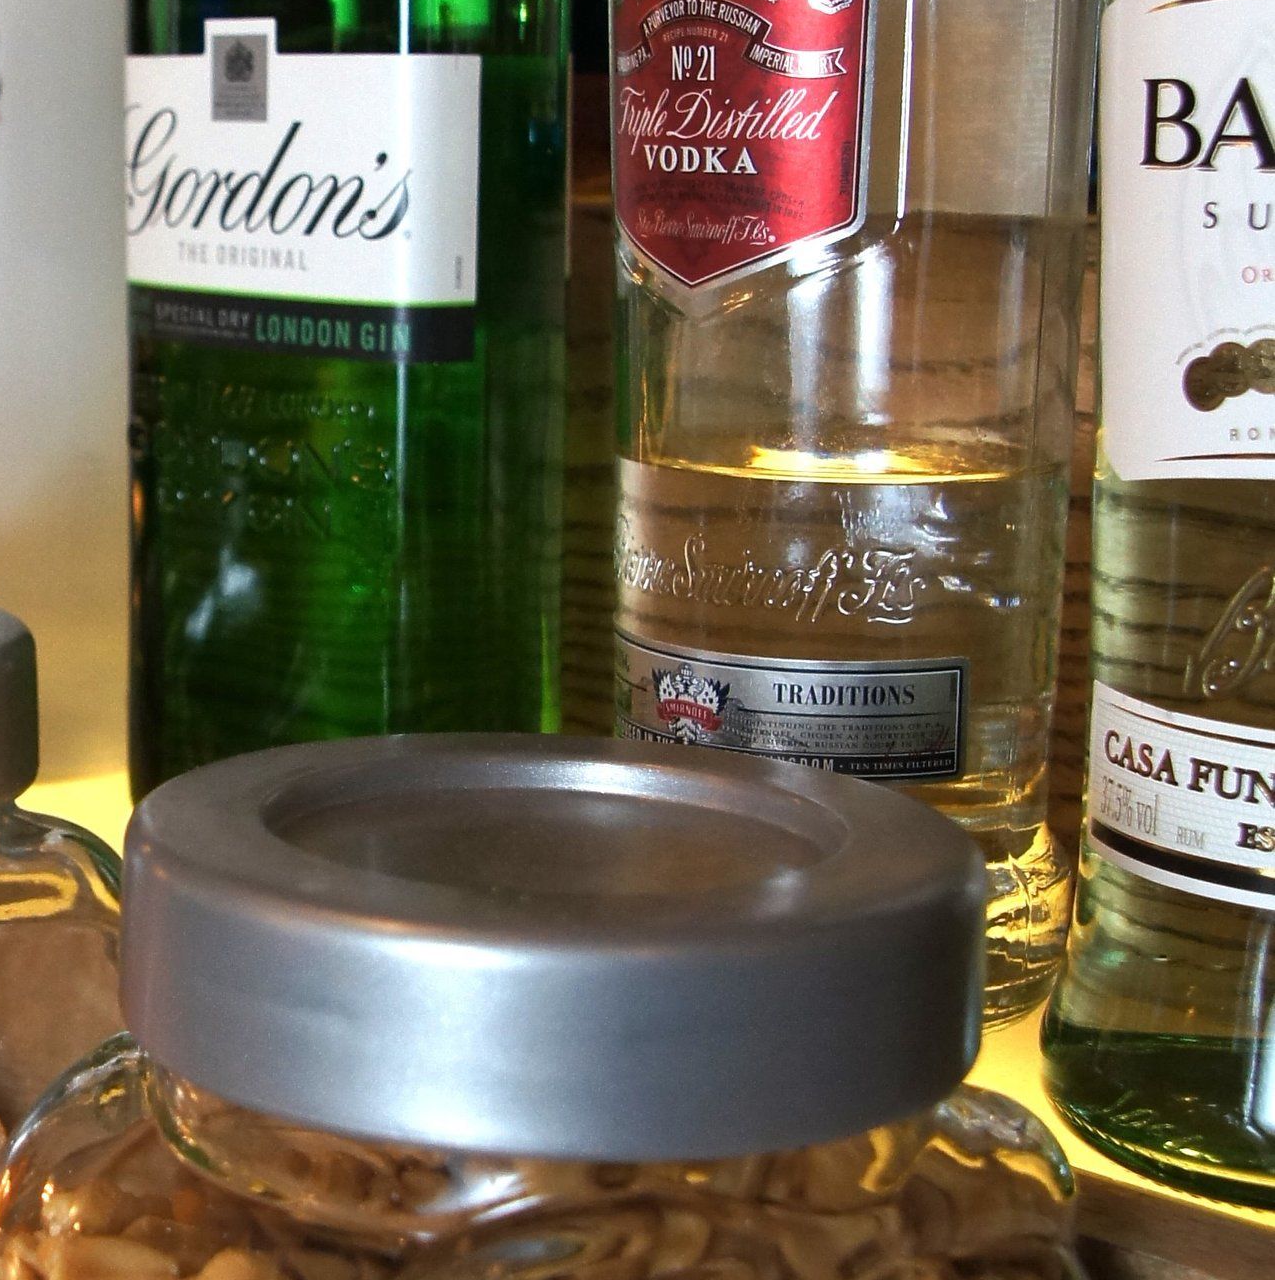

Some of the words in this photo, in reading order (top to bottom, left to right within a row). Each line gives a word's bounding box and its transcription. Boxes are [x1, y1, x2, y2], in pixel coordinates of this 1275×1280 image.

[646, 1, 685, 33] PURVEYOR
[686, 0, 698, 15] TO
[699, 0, 717, 18] THE
[717, 3, 762, 36] RUSSIAN
[696, 44, 716, 81] 21
[749, 43, 795, 73] IMPERIAL
[618, 86, 670, 156] Triple
[666, 88, 839, 141] Distilled
[126, 104, 413, 241] Gordon's
[643, 144, 759, 175] VODKA
[178, 241, 208, 265] THE
[216, 243, 308, 271] ORIGINAL
[255, 314, 351, 349] LONDON
[359, 320, 411, 352] GIN
[773, 682, 916, 707] TRADITIONS
[1104, 729, 1179, 787] CASA
[1136, 794, 1158, 837] vol
[1175, 825, 1206, 850] RUM
